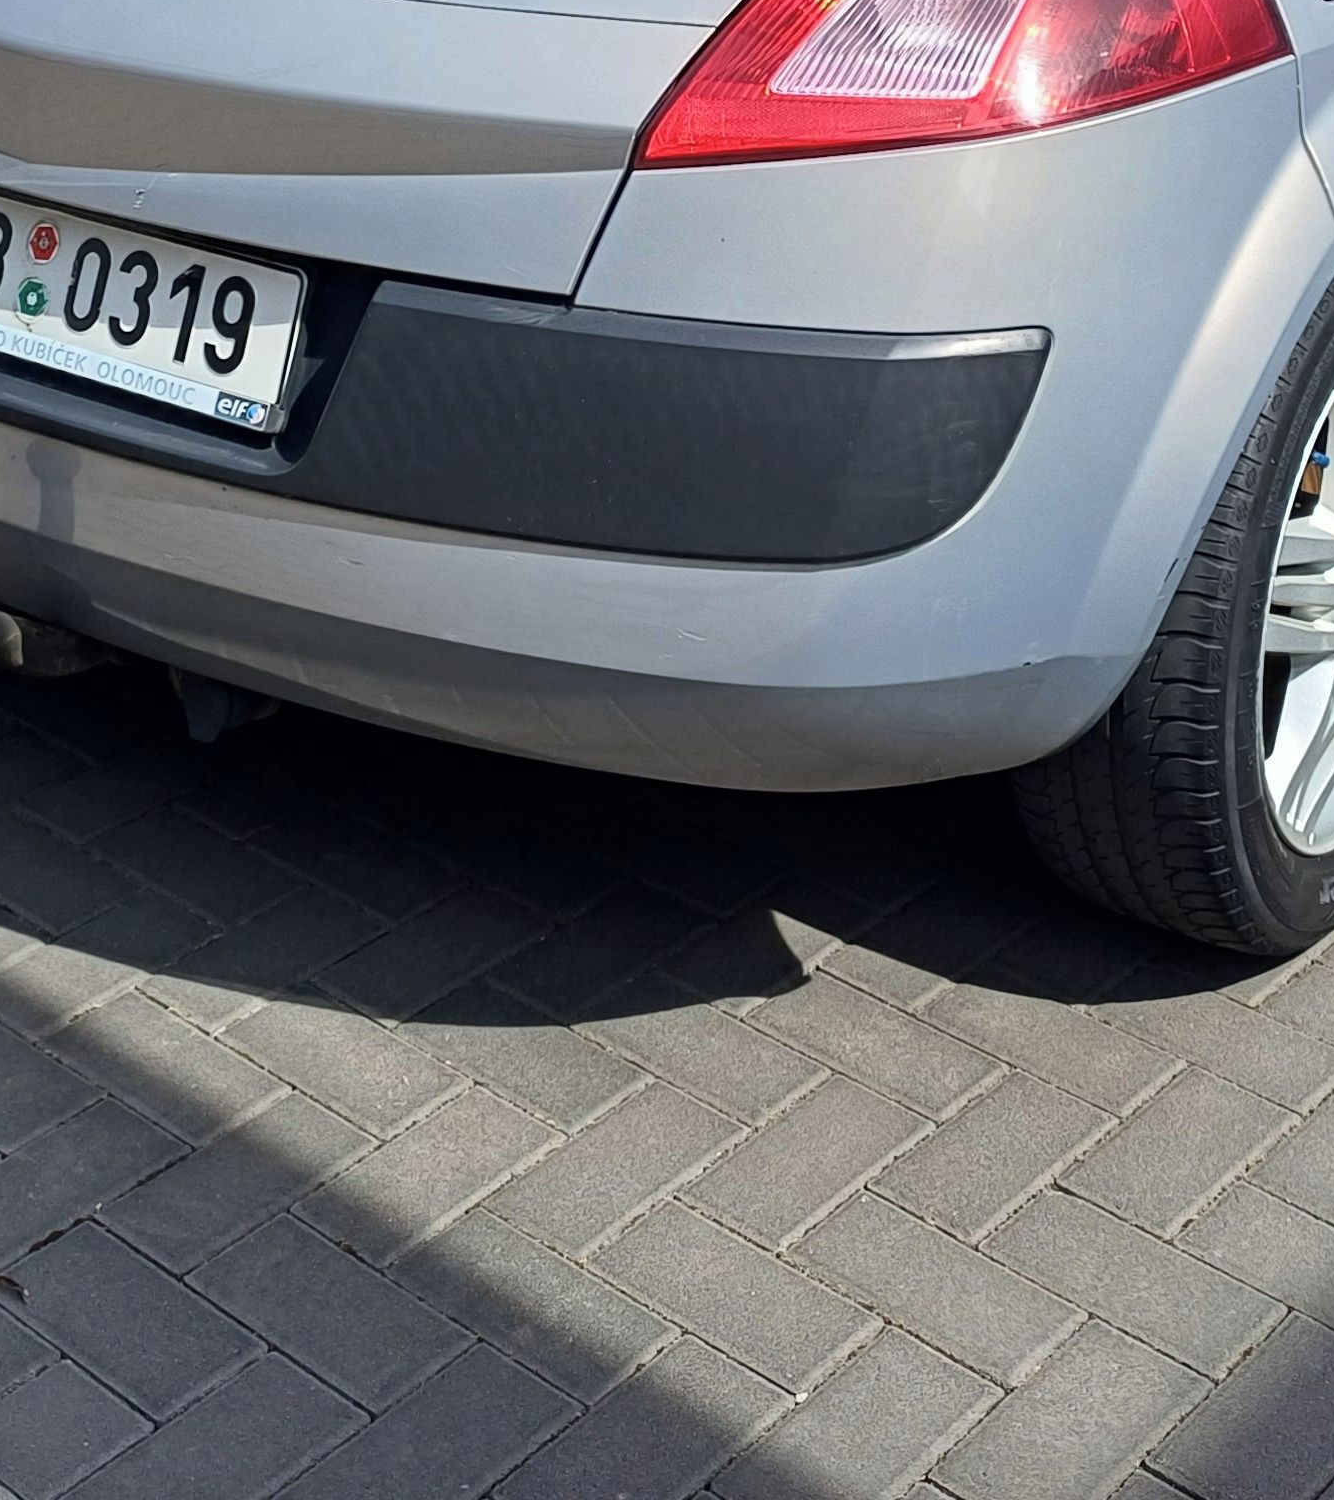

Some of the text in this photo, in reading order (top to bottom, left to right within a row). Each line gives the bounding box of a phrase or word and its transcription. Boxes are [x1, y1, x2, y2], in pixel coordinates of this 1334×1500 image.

[63, 237, 256, 375] 0319
[10, 335, 88, 373] KUBÍČEK
[97, 361, 196, 405] OLOMOUC
[216, 397, 248, 418] elf
